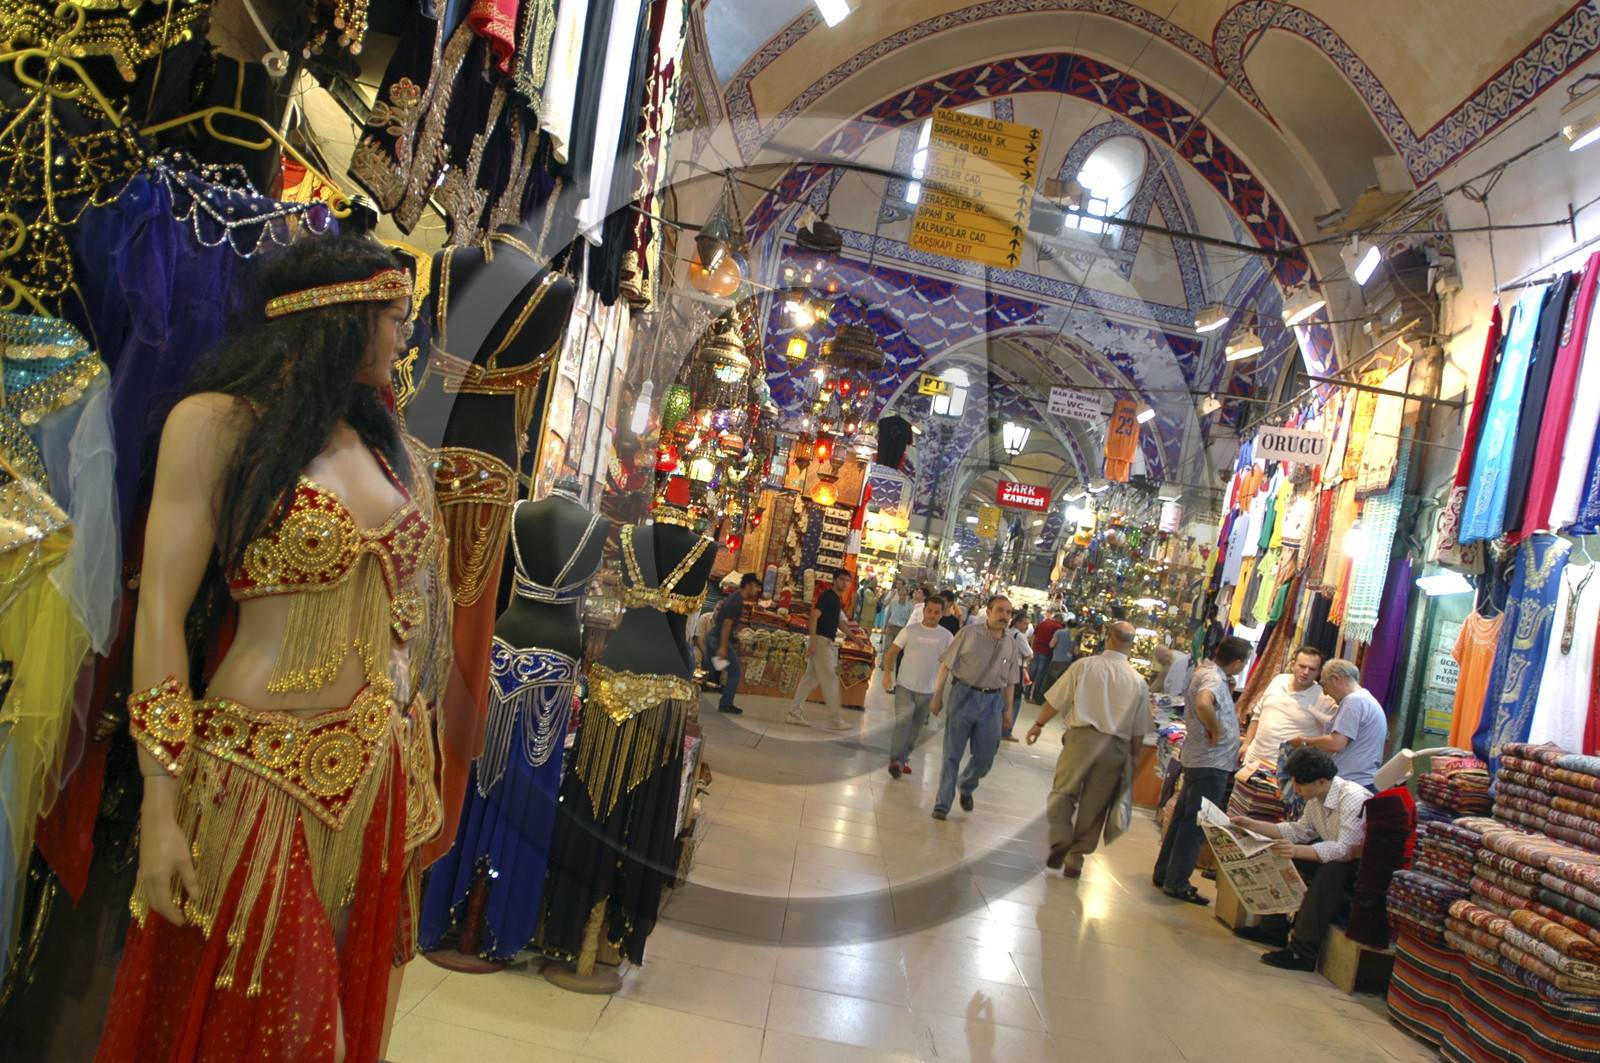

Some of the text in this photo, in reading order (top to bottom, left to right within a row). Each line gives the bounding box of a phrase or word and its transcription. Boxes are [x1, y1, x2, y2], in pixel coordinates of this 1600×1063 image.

[969, 231, 987, 244] CAD.
[955, 243, 973, 255] EXIT
[924, 377, 955, 391] PTT
[1052, 389, 1067, 398] MAN
[1076, 394, 1101, 405] WOMAN
[1066, 400, 1084, 410] WC
[1051, 406, 1065, 414] BAY
[1074, 409, 1096, 420] BAYAN
[1115, 415, 1135, 436] 23
[1005, 482, 1036, 496] ŞARK
